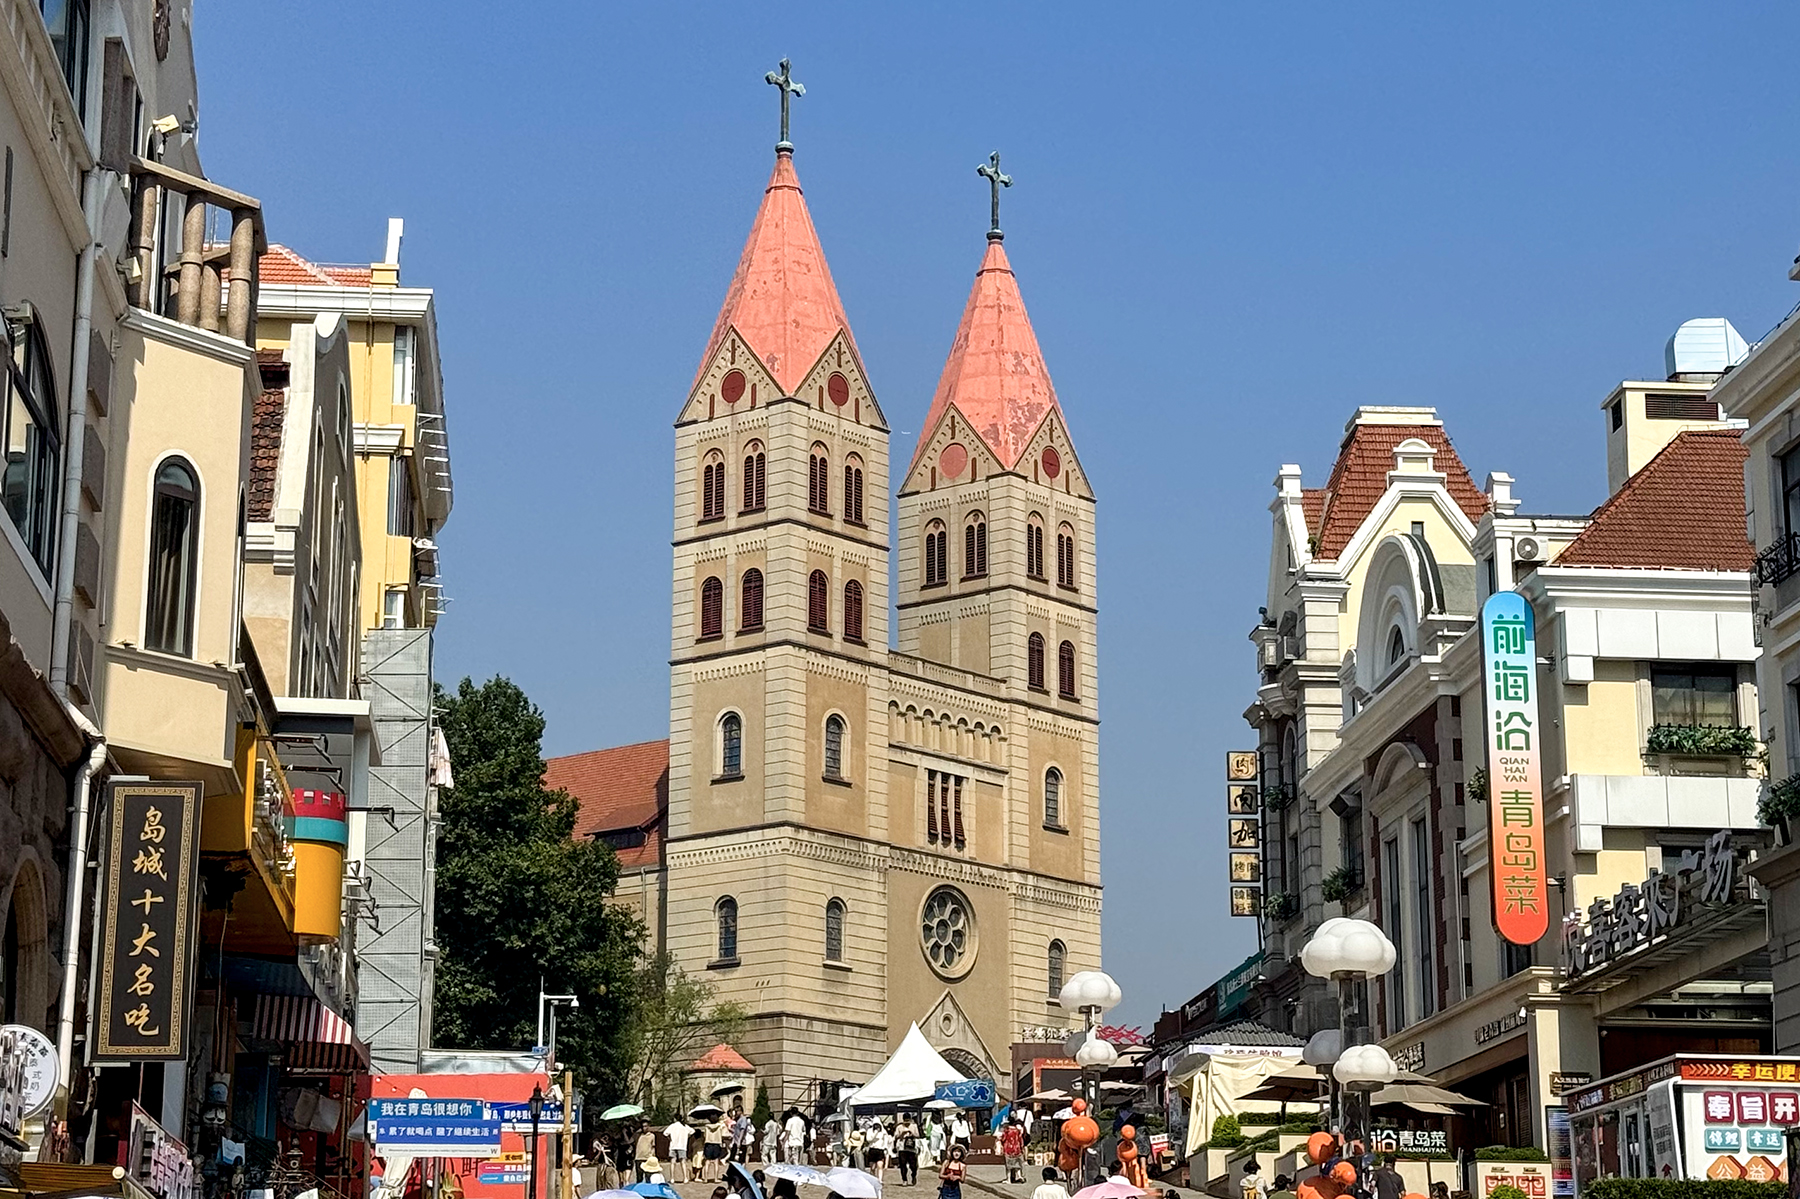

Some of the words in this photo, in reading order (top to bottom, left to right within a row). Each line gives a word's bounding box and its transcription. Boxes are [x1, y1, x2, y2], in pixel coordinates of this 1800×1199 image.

[1492, 613, 1532, 751] 前海沿
[1499, 757, 1530, 765] QIAN
[1504, 766, 1525, 774] HAI
[1503, 775, 1528, 783] YAN
[1500, 789, 1539, 915] 青岛菜
[124, 805, 168, 1036] 岛城十大名吃
[1731, 1063, 1796, 1080] 幸运便
[381, 1102, 472, 1116] 我在青岛很想你
[1708, 1095, 1796, 1120] 奉旨开
[1399, 1130, 1446, 1147] 青岛菜
